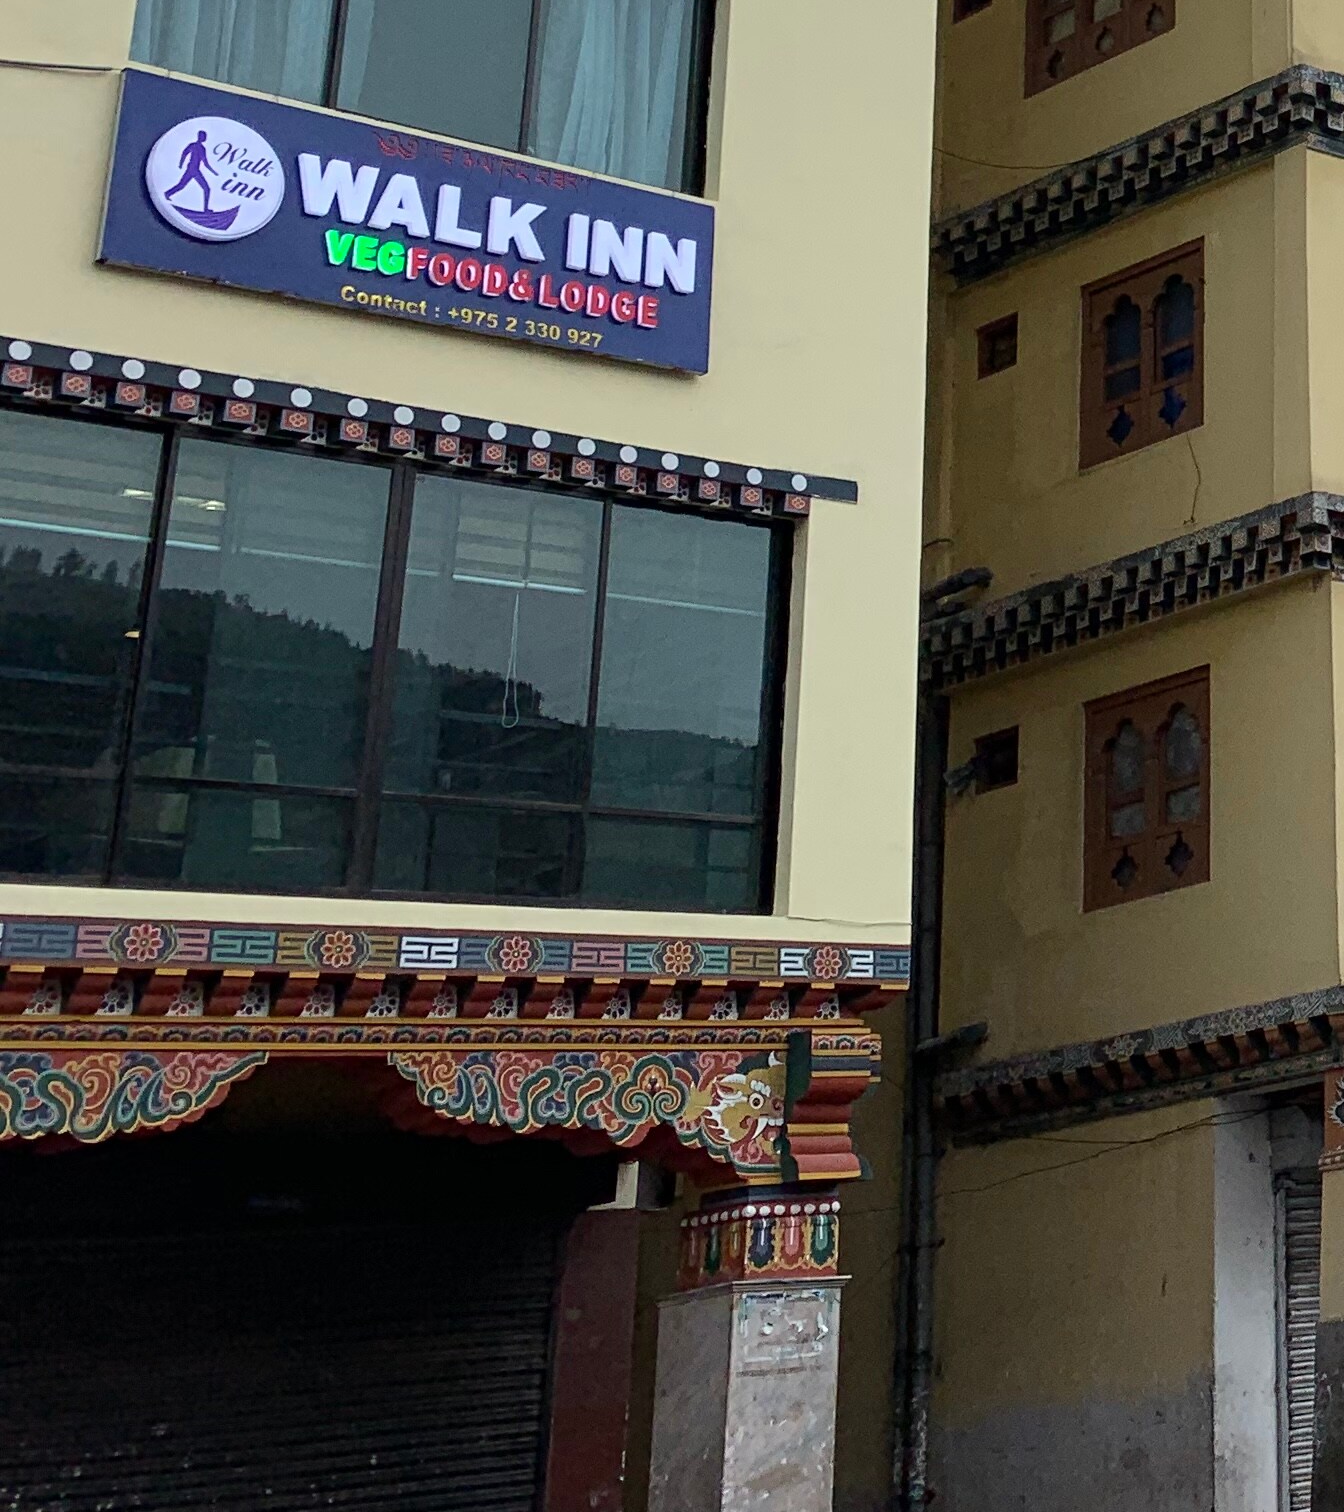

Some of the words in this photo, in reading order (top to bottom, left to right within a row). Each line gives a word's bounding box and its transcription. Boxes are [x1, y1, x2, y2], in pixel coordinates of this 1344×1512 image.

[213, 141, 274, 177] Walk
[221, 172, 266, 201] inn
[298, 152, 546, 263] WALK
[565, 213, 698, 294] INN
[340, 285, 428, 317] Contact
[447, 307, 499, 330] +975
[505, 317, 518, 332] 2
[525, 319, 562, 342] 330
[567, 328, 604, 349] 927
